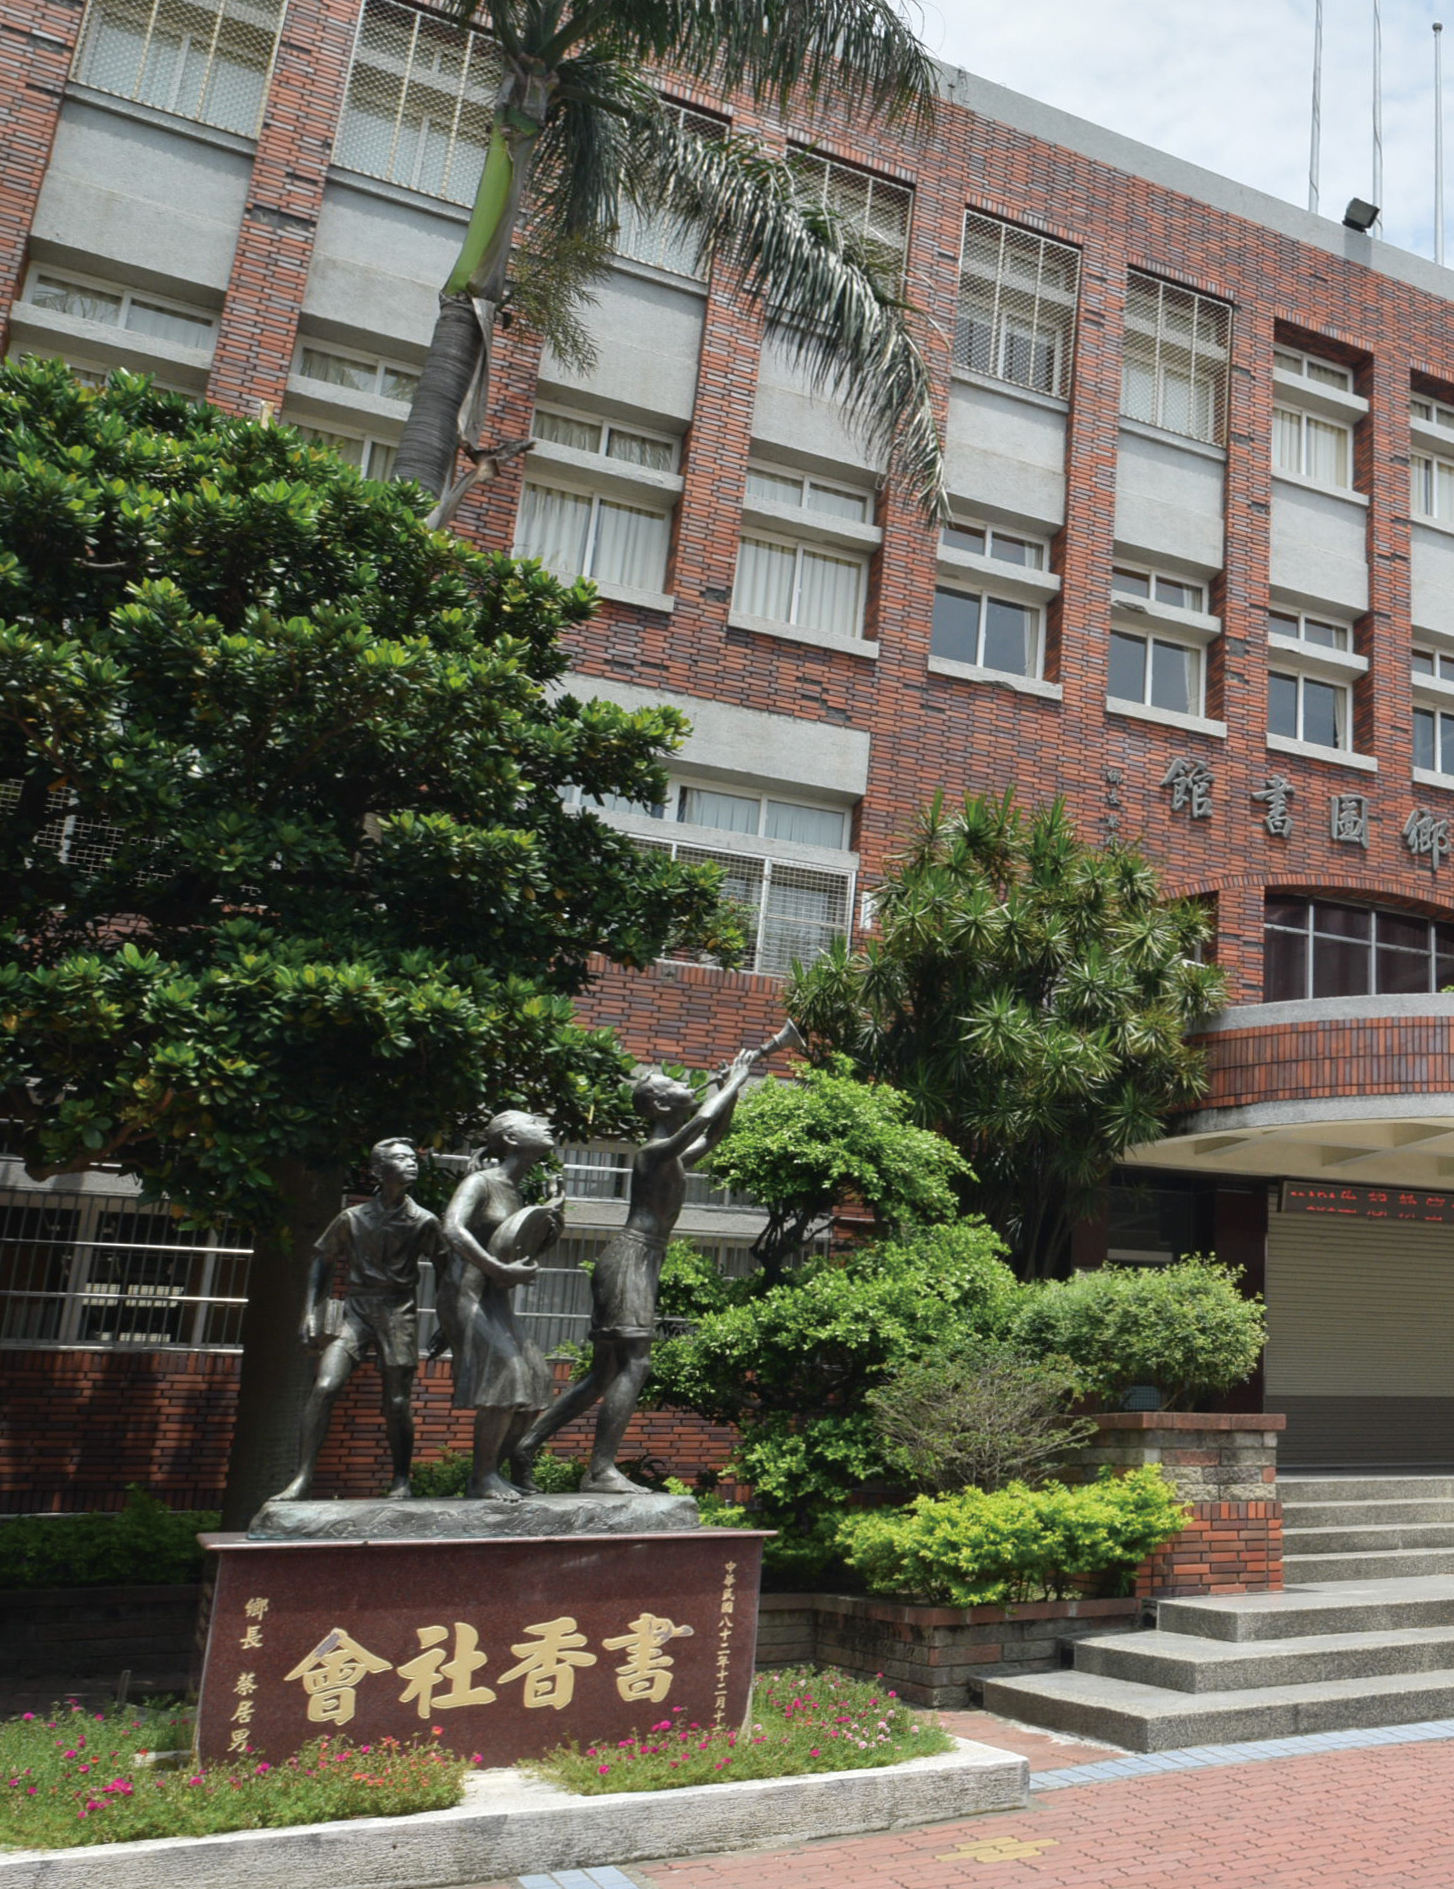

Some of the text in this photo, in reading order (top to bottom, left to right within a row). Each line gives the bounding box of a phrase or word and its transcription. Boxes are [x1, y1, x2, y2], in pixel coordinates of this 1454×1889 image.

[227, 1597, 269, 1752] 鄉長 蔡居男
[284, 1612, 694, 1726] 書香社會
